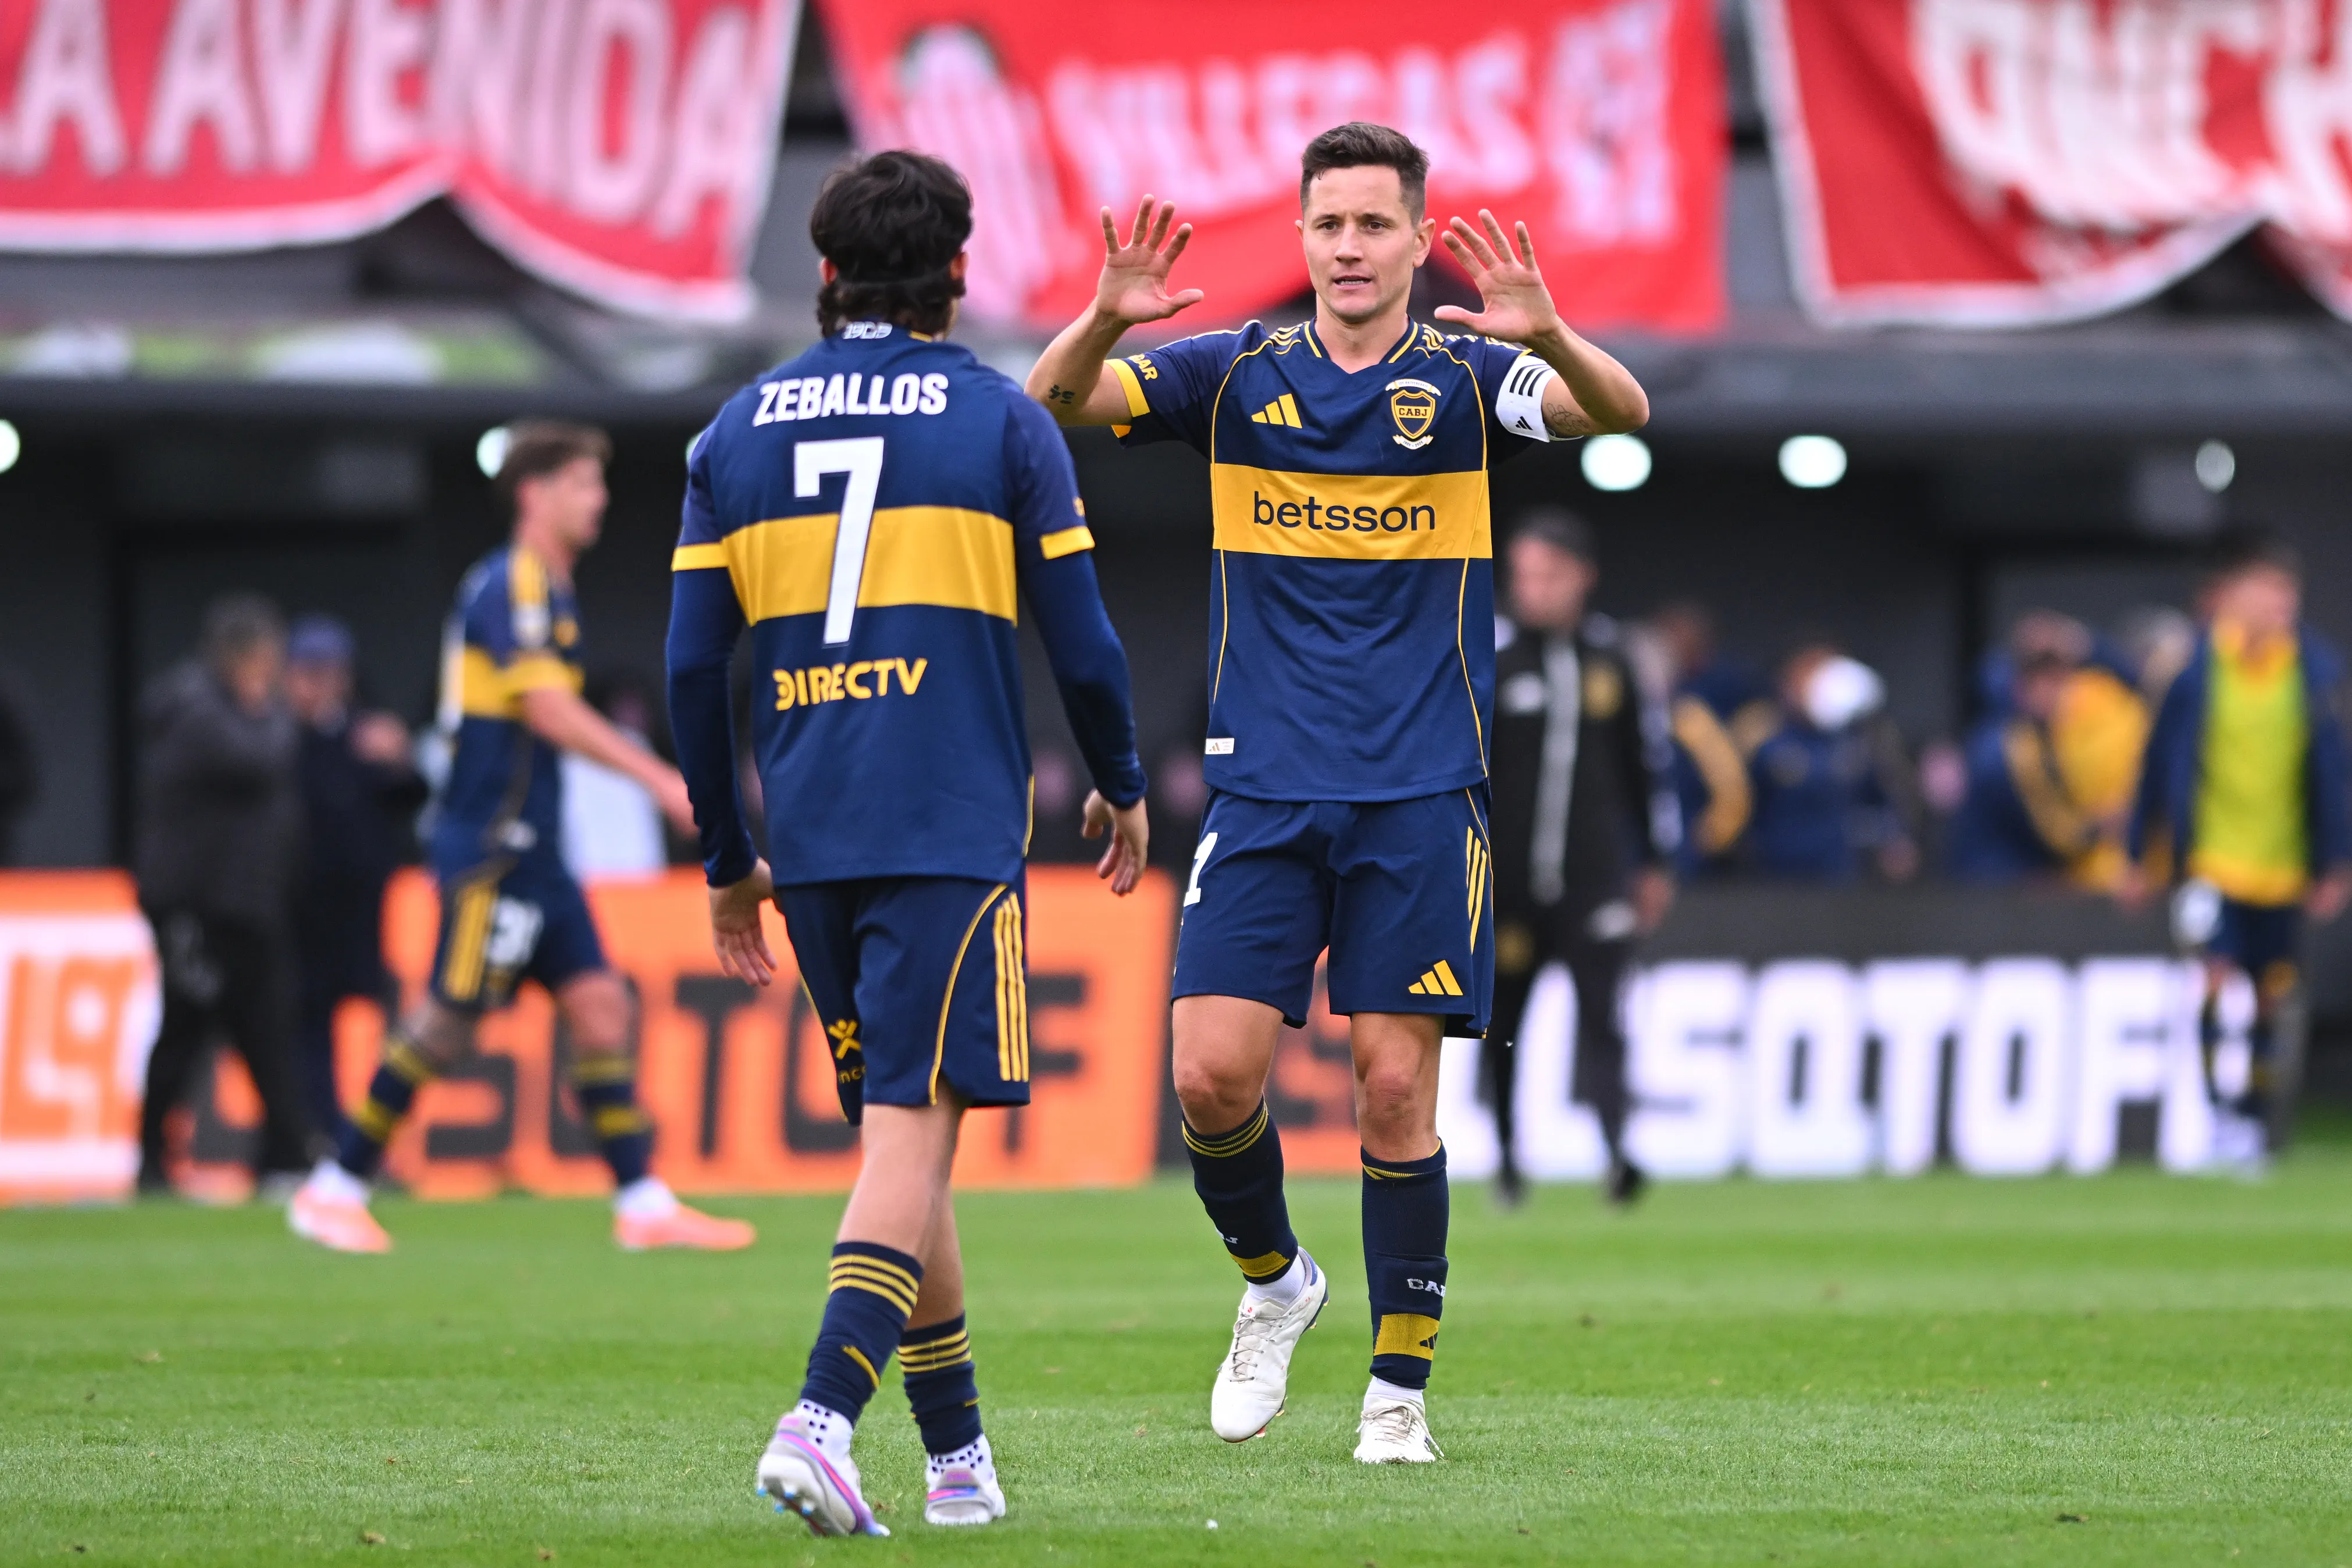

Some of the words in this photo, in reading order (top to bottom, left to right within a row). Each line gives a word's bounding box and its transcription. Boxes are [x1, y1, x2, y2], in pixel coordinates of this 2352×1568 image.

[0, 0, 127, 177] A
[752, 372, 949, 427] ZEBALLOS
[1399, 408, 1427, 416] CABJ
[1253, 491, 1435, 532] betsson
[794, 436, 885, 644] 7
[772, 657, 928, 711] DIRECTV
